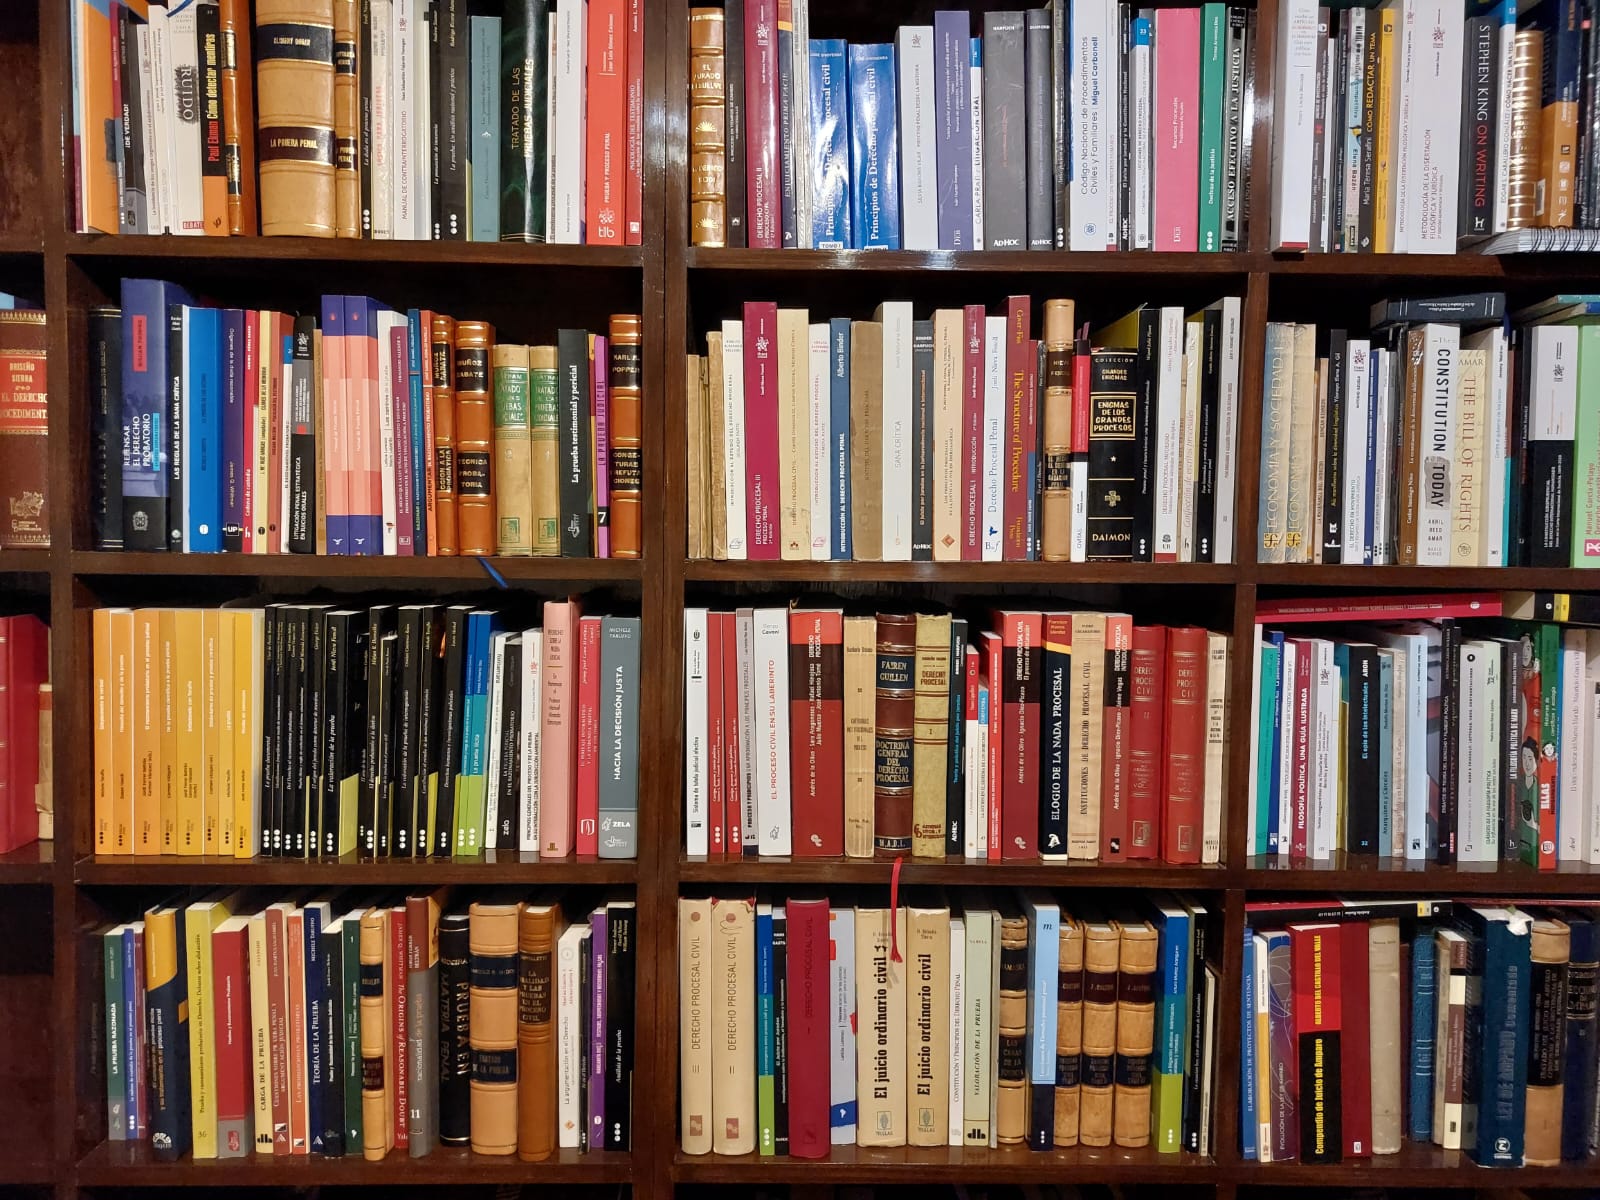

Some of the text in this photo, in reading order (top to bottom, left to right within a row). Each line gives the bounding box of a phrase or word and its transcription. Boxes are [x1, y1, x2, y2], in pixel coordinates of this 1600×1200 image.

[1369, 52, 1375, 62] UN
[181, 66, 193, 120] RUIDO
[206, 34, 219, 161] Paul Ekman Cómo detectar mentiras
[512, 90, 519, 101] DE
[1091, 80, 1099, 105] Miguel
[1367, 65, 1375, 108] REDACTAR
[1081, 108, 1088, 119] de
[1474, 25, 1489, 207] STEPHEN KING ON WRITING
[1081, 162, 1090, 194] Código
[172, 376, 180, 401] CRÍTICA
[570, 366, 578, 394] pericial
[174, 430, 180, 439] DE
[570, 402, 579, 444] testimonial
[1431, 349, 1450, 507] CONSTITUTION TODAY
[142, 414, 151, 466] PROBATORIO
[1459, 376, 1475, 531] THE BILL OF RIGHTS
[133, 457, 140, 466] EL
[572, 446, 580, 472] prueba
[989, 444, 998, 476] Procesal
[572, 474, 578, 482] La
[988, 479, 997, 512] Derecho
[1092, 533, 1131, 541] DAIMON
[1082, 661, 1090, 678] CIVIL
[769, 706, 775, 716] SU
[1082, 683, 1090, 715] PROCESAL
[613, 696, 623, 735] DECISIÓN
[769, 718, 775, 727] EN
[614, 738, 621, 749] LA
[1052, 668, 1062, 820] ELOGIO DE LA NADA PROCESAL
[1080, 720, 1089, 750] DERECHO
[691, 936, 700, 1050] DERECHO PROCESAL CIVIL
[313, 1032, 319, 1040] LA
[728, 1010, 736, 1050] DERECHO
[874, 957, 889, 1098] El juicio ordinario civil
[918, 954, 933, 1095] El juicio ordinario civil
[314, 1042, 319, 1053] DE
[259, 1060, 264, 1069] LA
[260, 1074, 265, 1083] DE
[312, 1056, 320, 1084] TEORÍA
[1314, 1039, 1324, 1154] Compendio de Juicio de Amparo
